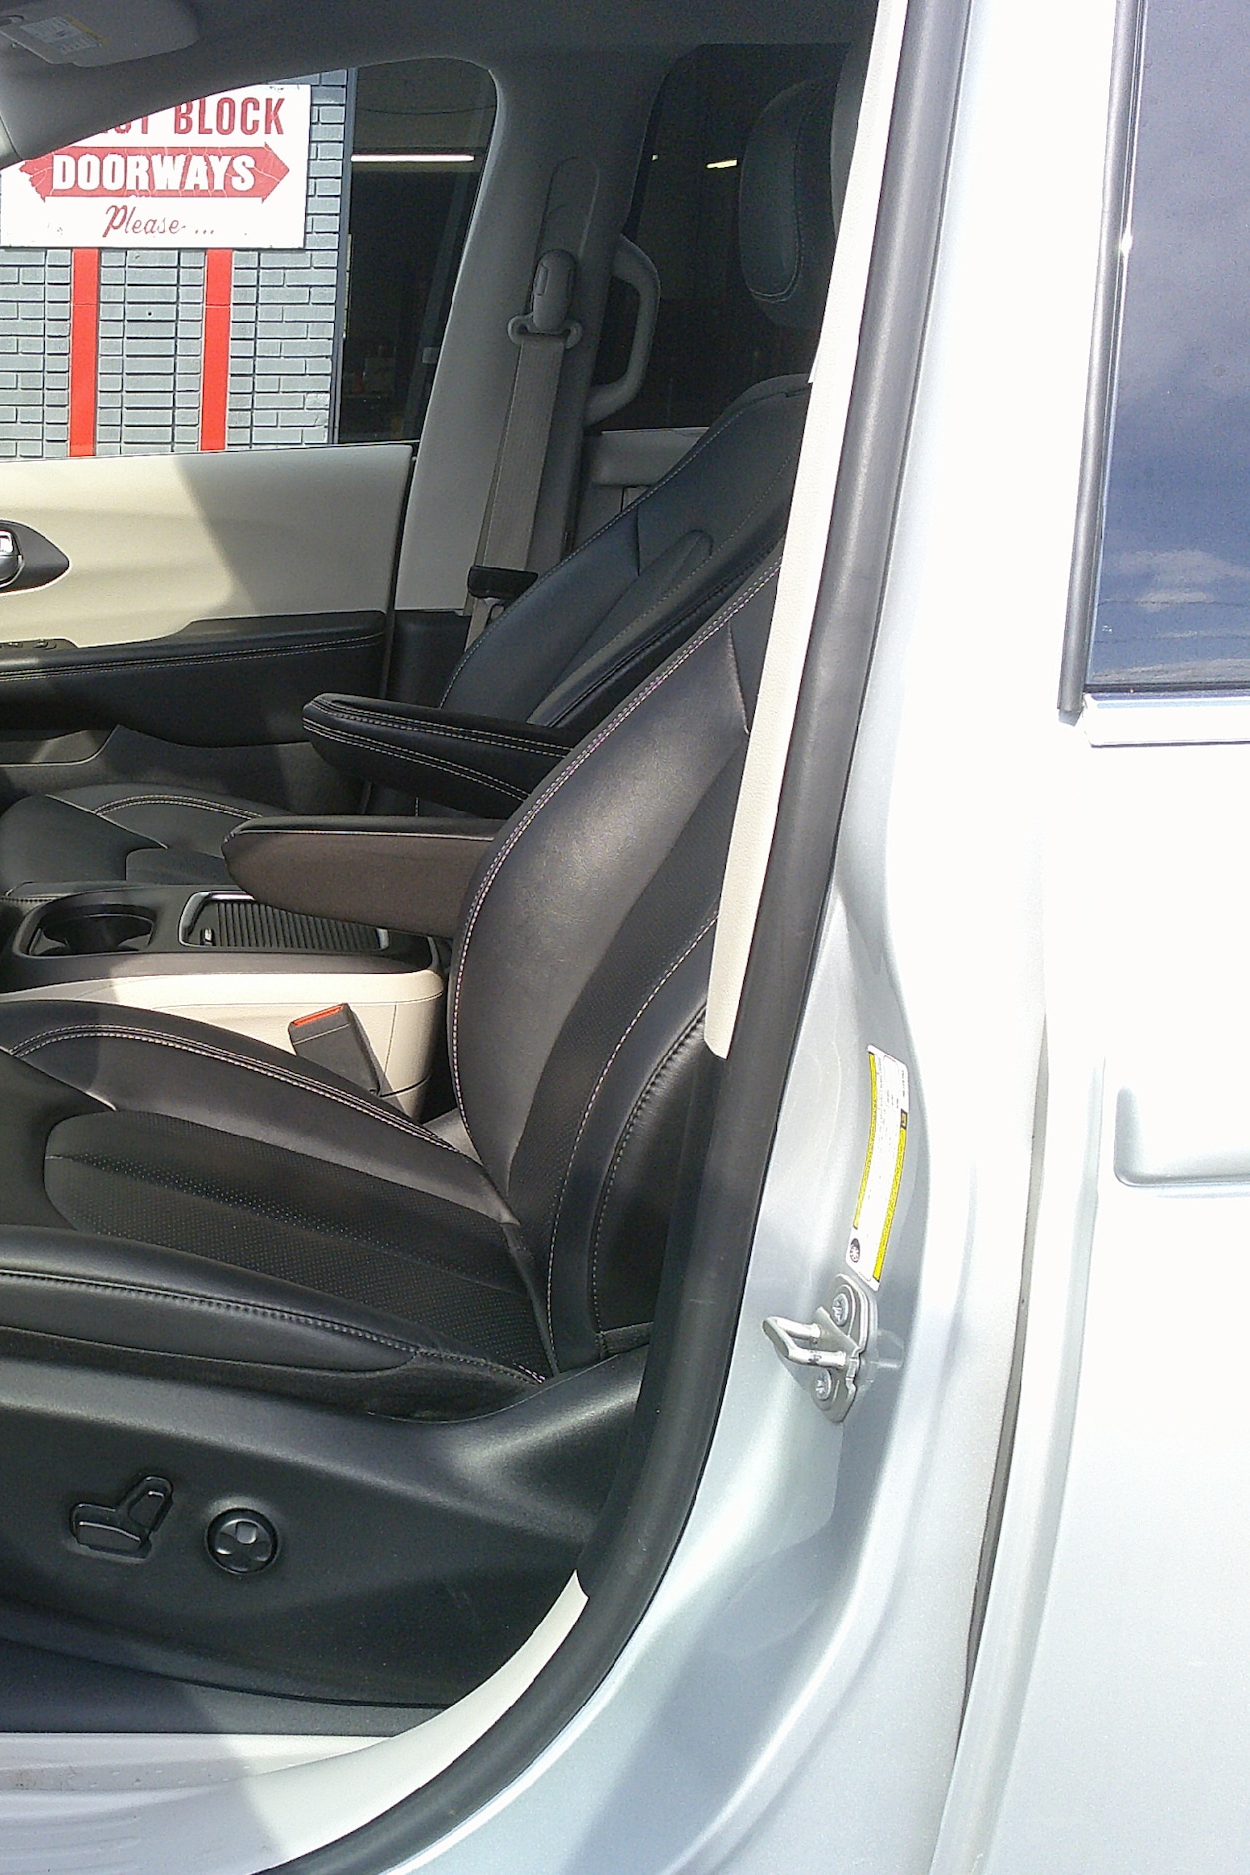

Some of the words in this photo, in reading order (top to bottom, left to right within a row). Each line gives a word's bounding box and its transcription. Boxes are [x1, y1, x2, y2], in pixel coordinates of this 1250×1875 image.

[173, 97, 285, 135] BLOCK
[52, 153, 256, 191] DOORWAYS
[102, 204, 186, 238] Please
